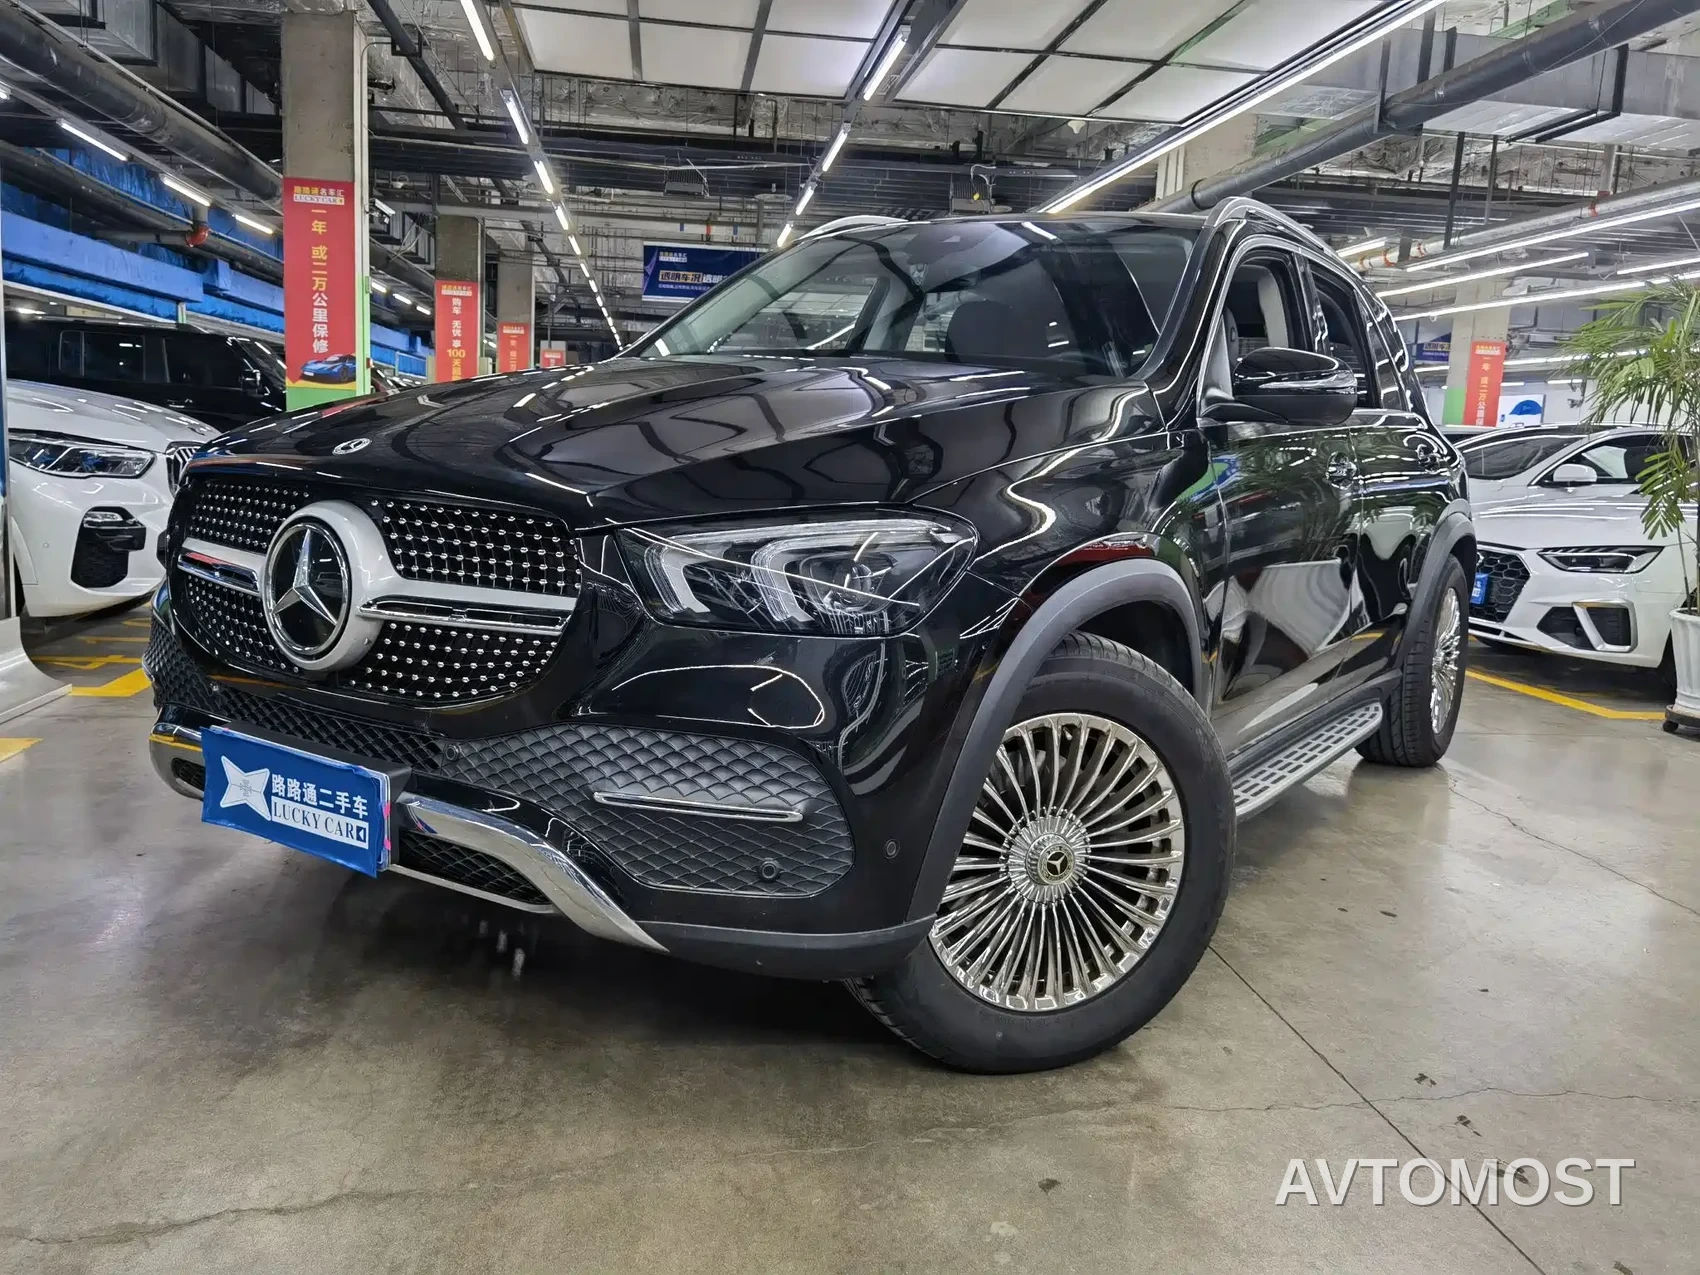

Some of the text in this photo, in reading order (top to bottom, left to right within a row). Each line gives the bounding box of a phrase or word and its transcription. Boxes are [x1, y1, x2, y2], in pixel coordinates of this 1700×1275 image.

[271, 773, 369, 819] 路路通二手车
[272, 801, 355, 841] LUCKY CAR
